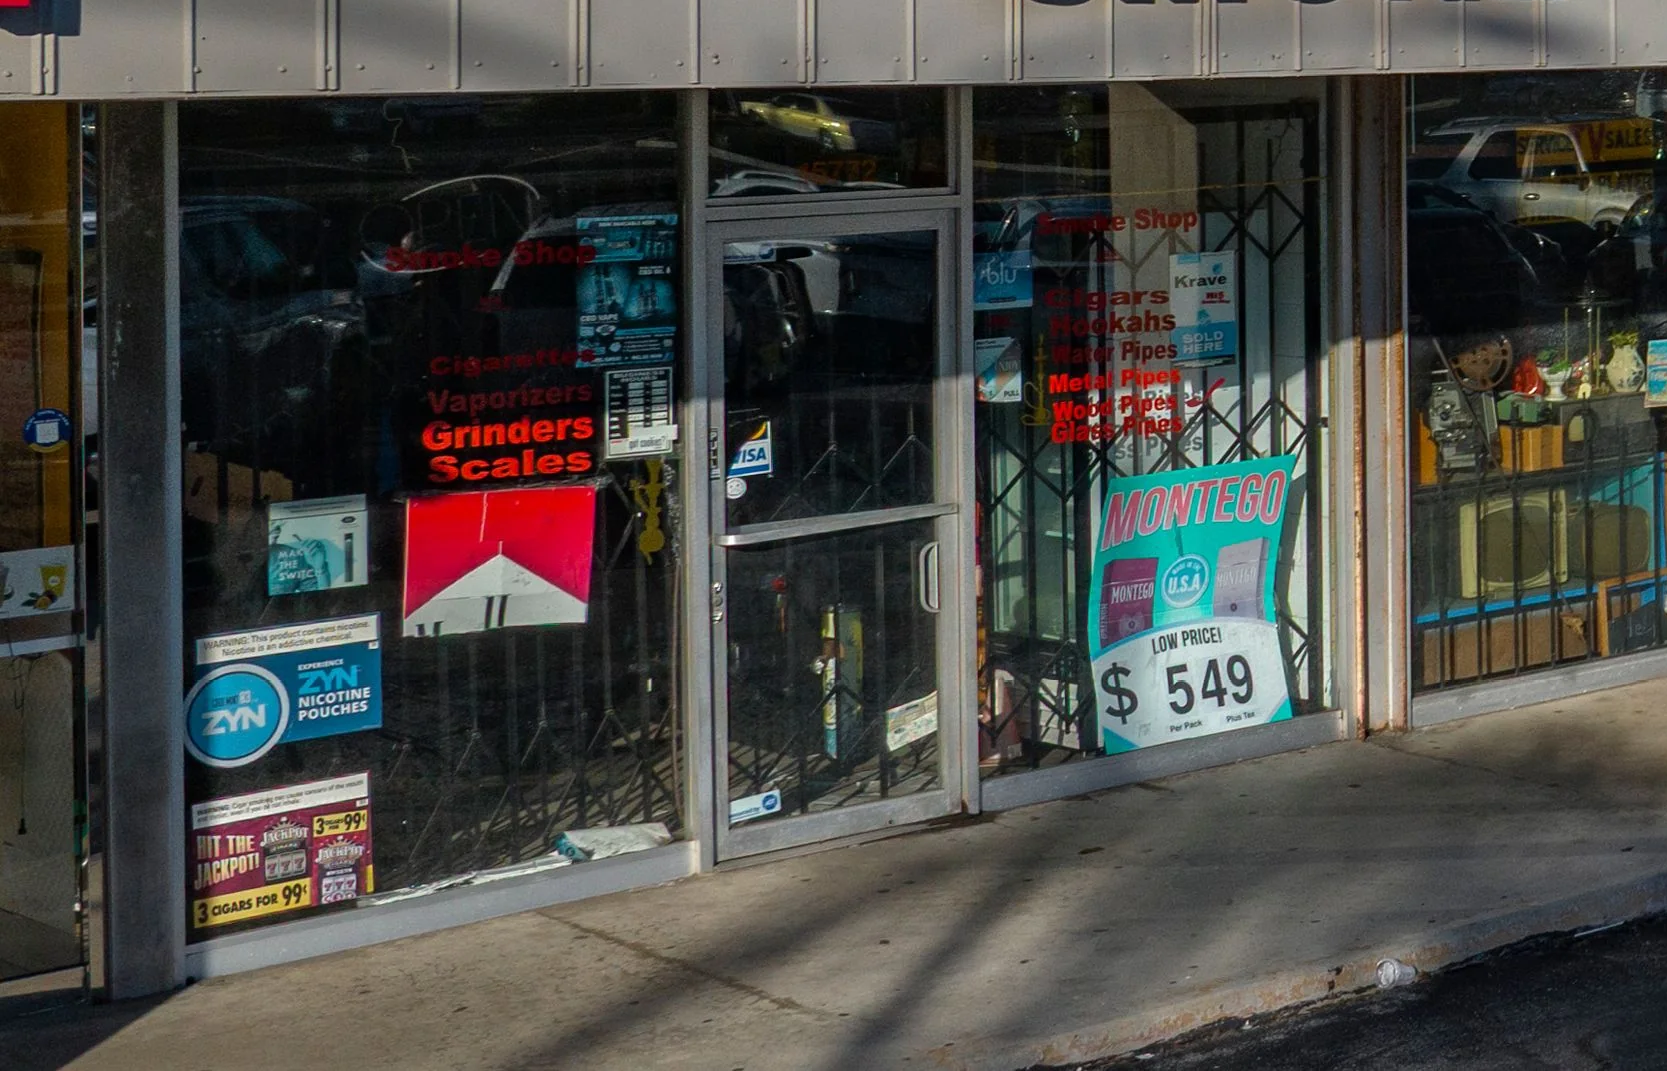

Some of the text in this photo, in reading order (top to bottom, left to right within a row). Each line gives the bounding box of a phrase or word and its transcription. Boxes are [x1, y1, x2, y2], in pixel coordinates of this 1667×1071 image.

[1036, 208, 1198, 236] Smoke Shop
[385, 239, 597, 272] Smoke Shop
[986, 261, 1017, 286] blu
[1174, 274, 1228, 289] Krave
[1043, 287, 1170, 311] Cigars
[1049, 309, 1177, 338] Hookahs
[1183, 330, 1224, 345] SOLD
[1183, 341, 1225, 355] HERE
[429, 346, 597, 378] Cigarettes
[1051, 340, 1178, 366] Water Pipes
[1049, 367, 1182, 394] Metal Pipes
[427, 383, 593, 417] Vaporizers
[1052, 393, 1179, 422] Wood Pipes
[421, 415, 595, 451] Grinders
[1051, 415, 1183, 444] Glass Pipes
[428, 448, 593, 484] Scales
[1101, 468, 1288, 553] MONTEGO
[1216, 566, 1257, 589] MONTEGO
[1111, 581, 1155, 605] MONTEGO
[222, 645, 256, 657] Nicotine
[257, 642, 265, 652] is
[266, 643, 277, 651] an
[278, 636, 315, 650] addictive
[251, 633, 269, 642] This
[270, 630, 301, 643] product
[302, 625, 336, 636] contains
[1151, 626, 1223, 655] LOW PRICE!
[297, 658, 344, 671] EXPERIENCE
[300, 665, 359, 695] ZYN
[298, 686, 371, 709] NICOTINE
[1100, 662, 1139, 725] $
[201, 703, 267, 737] ZYN
[298, 701, 369, 722] POUCHES
[1169, 712, 1256, 733] Per Pack Plus Tax
[260, 826, 309, 847] JACKPOT
[316, 817, 325, 834] 3
[196, 834, 256, 860] HIT THE
[194, 852, 261, 891] JACKPOT!
[197, 902, 209, 924] 3
[211, 898, 253, 917] CIGARS
[256, 894, 279, 906] FOR
